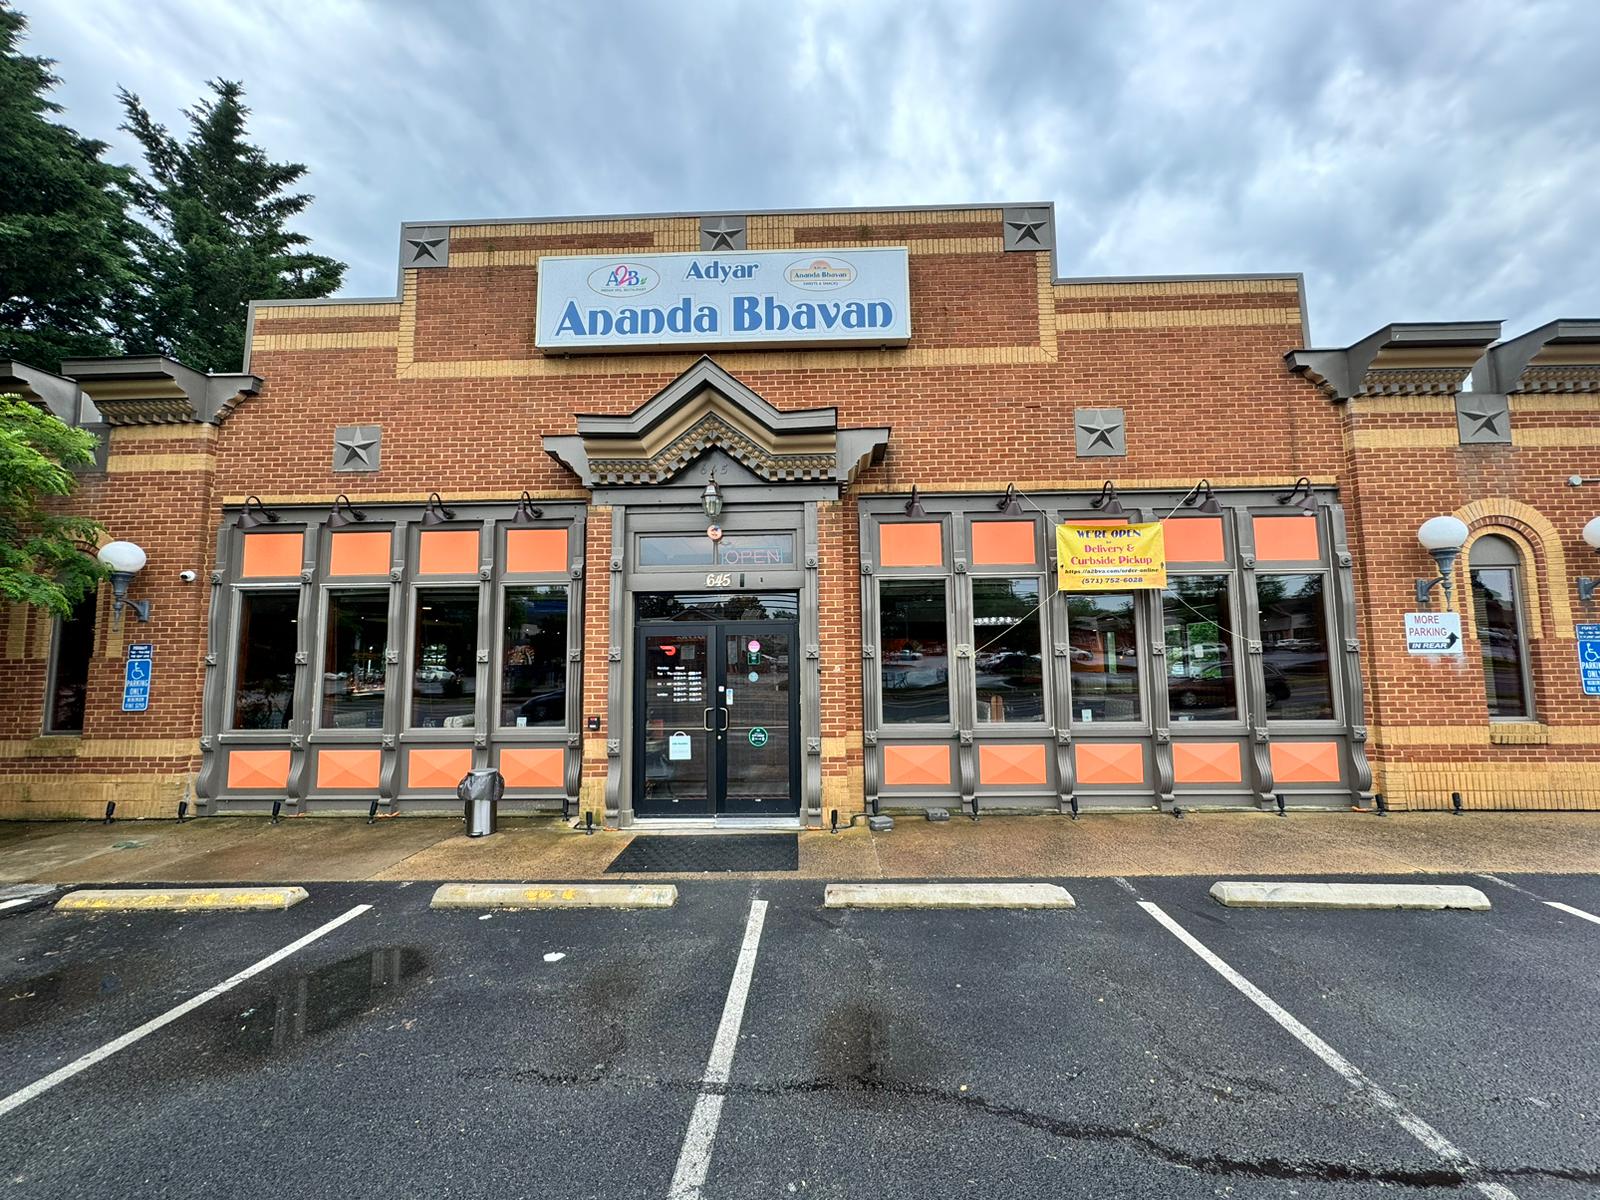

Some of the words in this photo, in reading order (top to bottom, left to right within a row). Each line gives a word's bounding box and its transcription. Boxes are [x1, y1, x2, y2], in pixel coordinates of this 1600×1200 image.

[605, 265, 640, 286] A2B
[686, 260, 759, 285] Adyar
[555, 297, 718, 336] Ananda
[733, 296, 893, 332] Bhavan
[1077, 529, 1107, 538] WE'RE
[1111, 529, 1141, 537] OPEN
[1084, 545, 1123, 553] Delivery
[1127, 544, 1134, 552] &
[726, 549, 780, 564] OPEN
[1071, 556, 1116, 565] Curbside
[1119, 556, 1153, 565] Pickup
[706, 573, 731, 587] 645
[1414, 615, 1440, 624] MORE
[1409, 627, 1447, 636] PARKING
